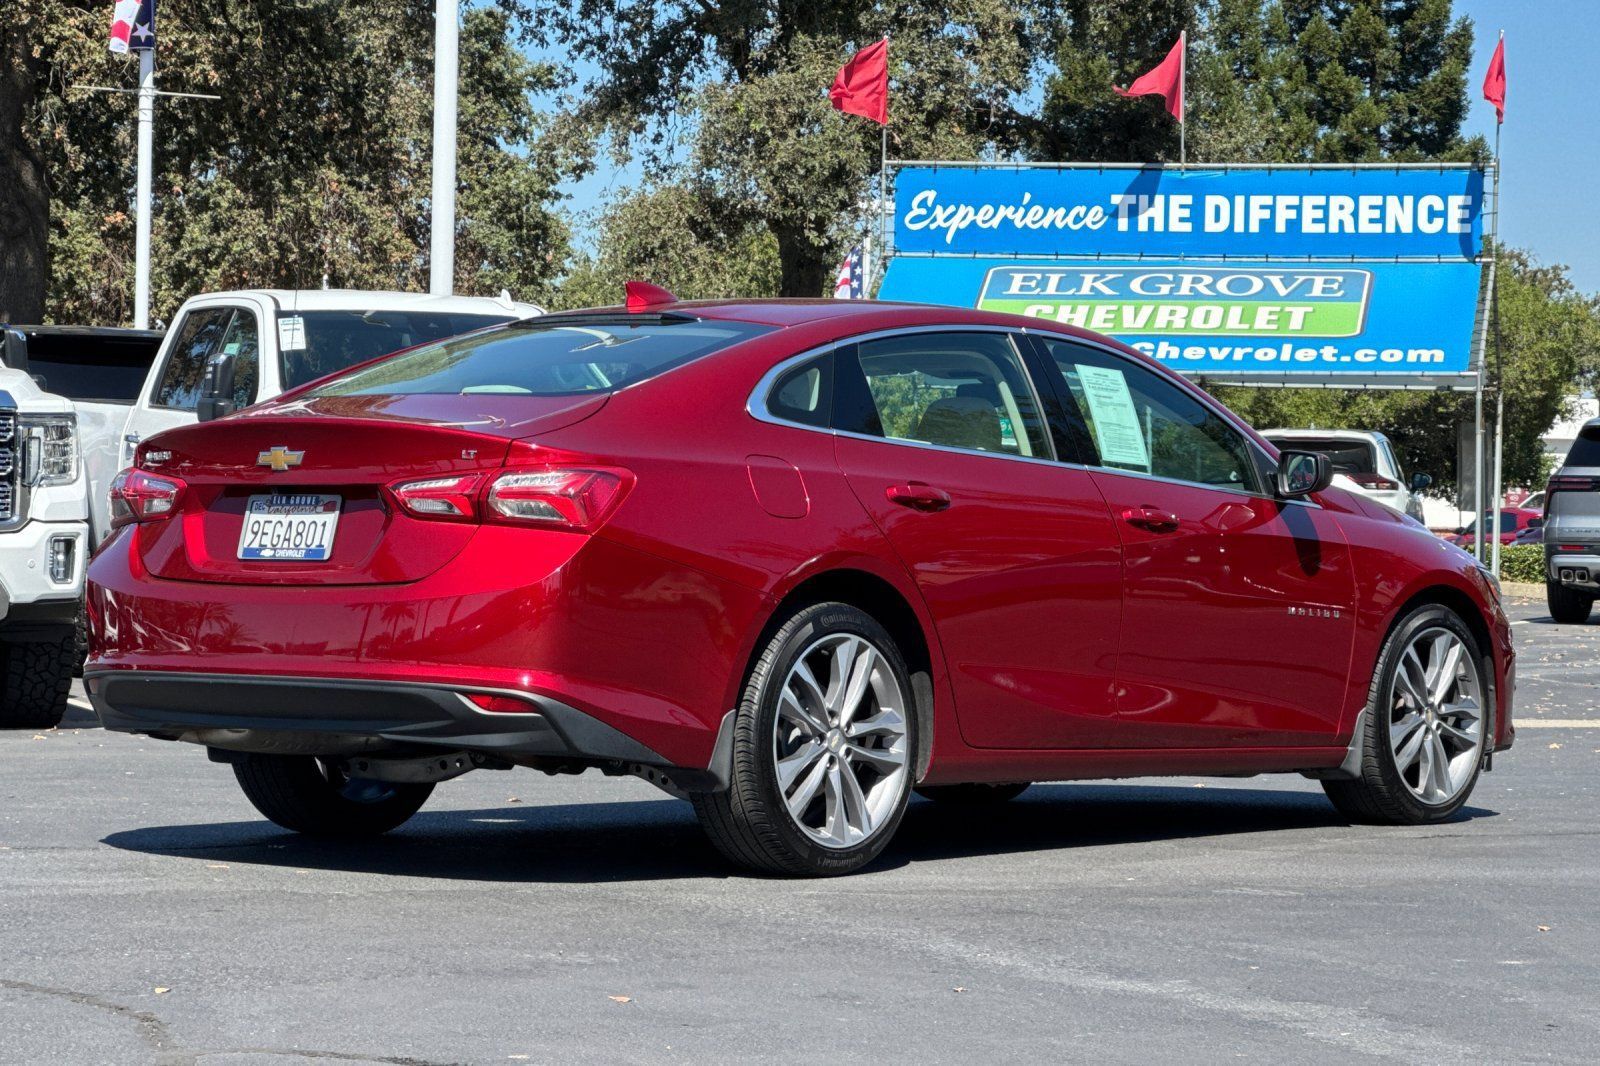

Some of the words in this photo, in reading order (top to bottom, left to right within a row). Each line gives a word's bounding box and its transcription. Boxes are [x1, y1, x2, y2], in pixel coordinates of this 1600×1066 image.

[904, 190, 1108, 244] Experience
[1110, 194, 1193, 232] THE
[1204, 194, 1473, 234] DIFFERENCE
[1002, 273, 1124, 296] ELK
[1129, 273, 1345, 297] GROVE
[461, 449, 478, 459] LT
[272, 496, 286, 505] ELK
[289, 496, 317, 505] GROVE
[247, 520, 327, 548] 9EGA801
[275, 549, 306, 557] CHEVROLET
[1287, 606, 1340, 619] MALIBU
